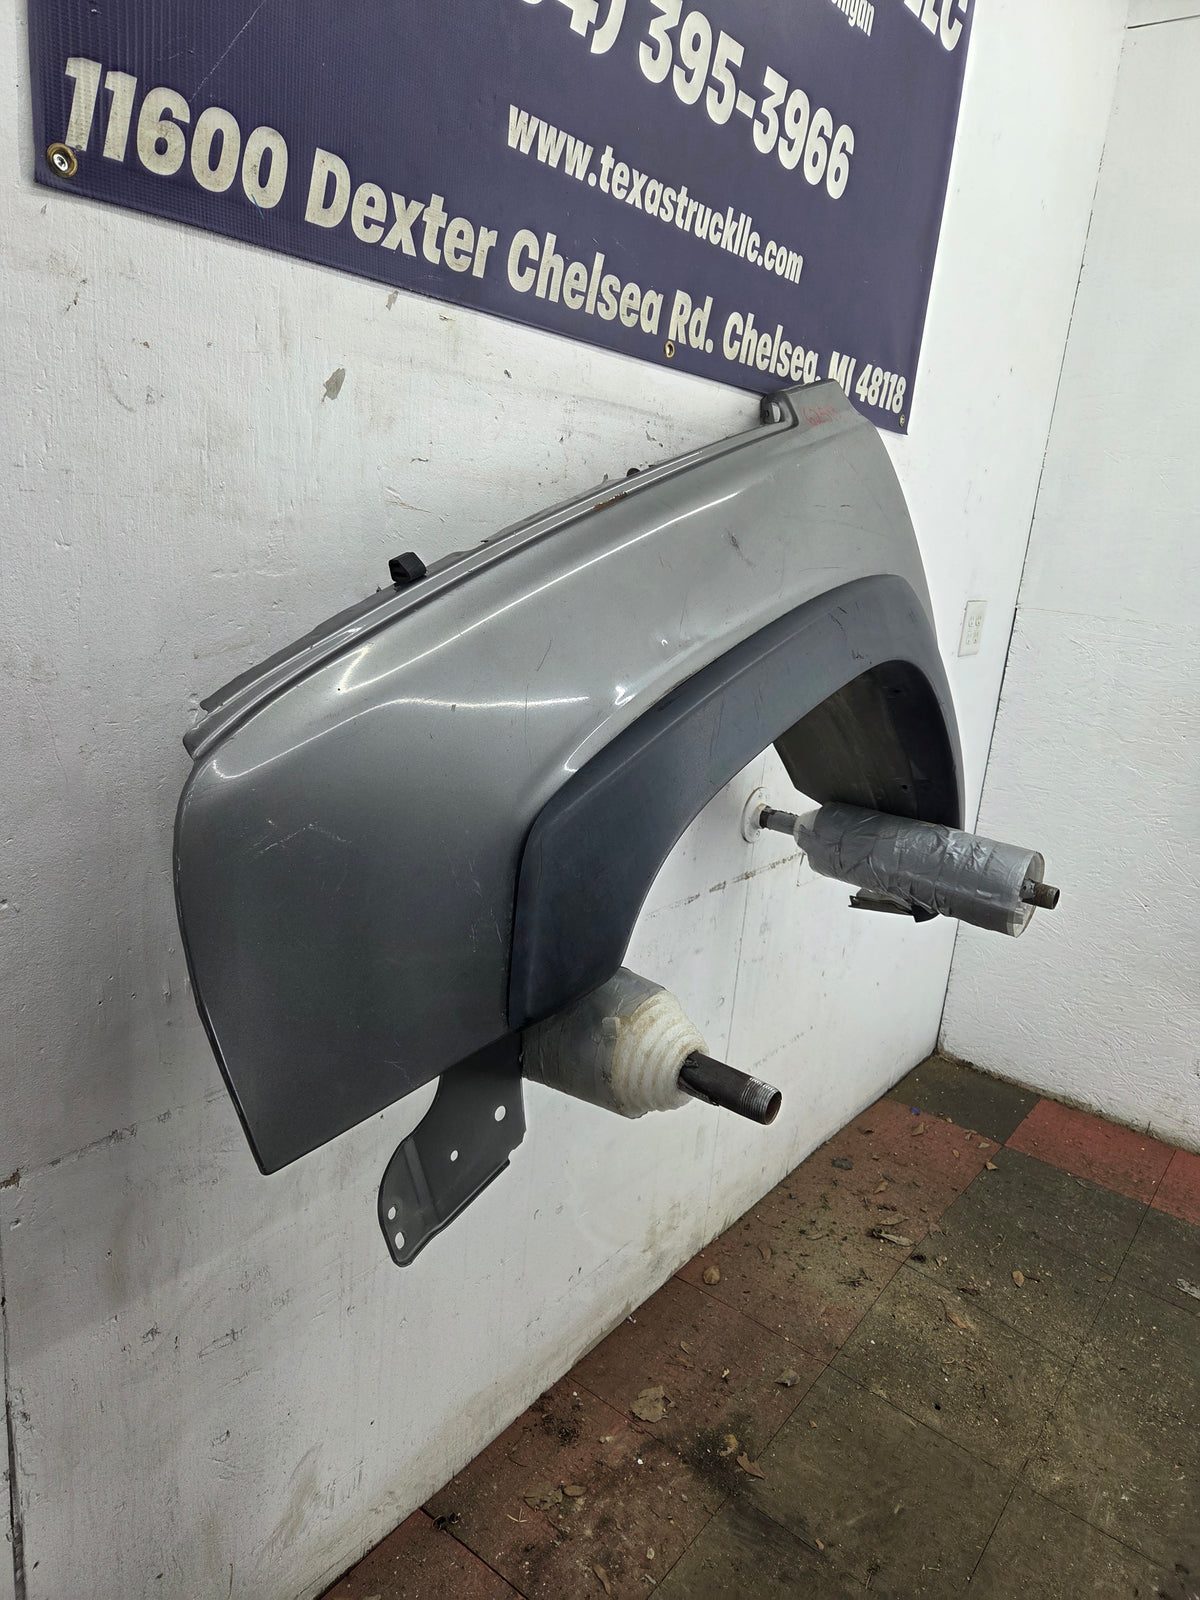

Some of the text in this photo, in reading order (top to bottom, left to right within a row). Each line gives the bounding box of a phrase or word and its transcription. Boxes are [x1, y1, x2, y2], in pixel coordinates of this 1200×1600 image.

[507, 105, 804, 284] www.texastruckllc.com
[638, 0, 854, 200] 395-3966
[65, 57, 288, 209] 11600
[305, 147, 498, 279] Dexter
[507, 229, 664, 336] Chelsea
[668, 289, 714, 354] Rd.
[828, 350, 857, 398] MI
[855, 363, 907, 414] 48118
